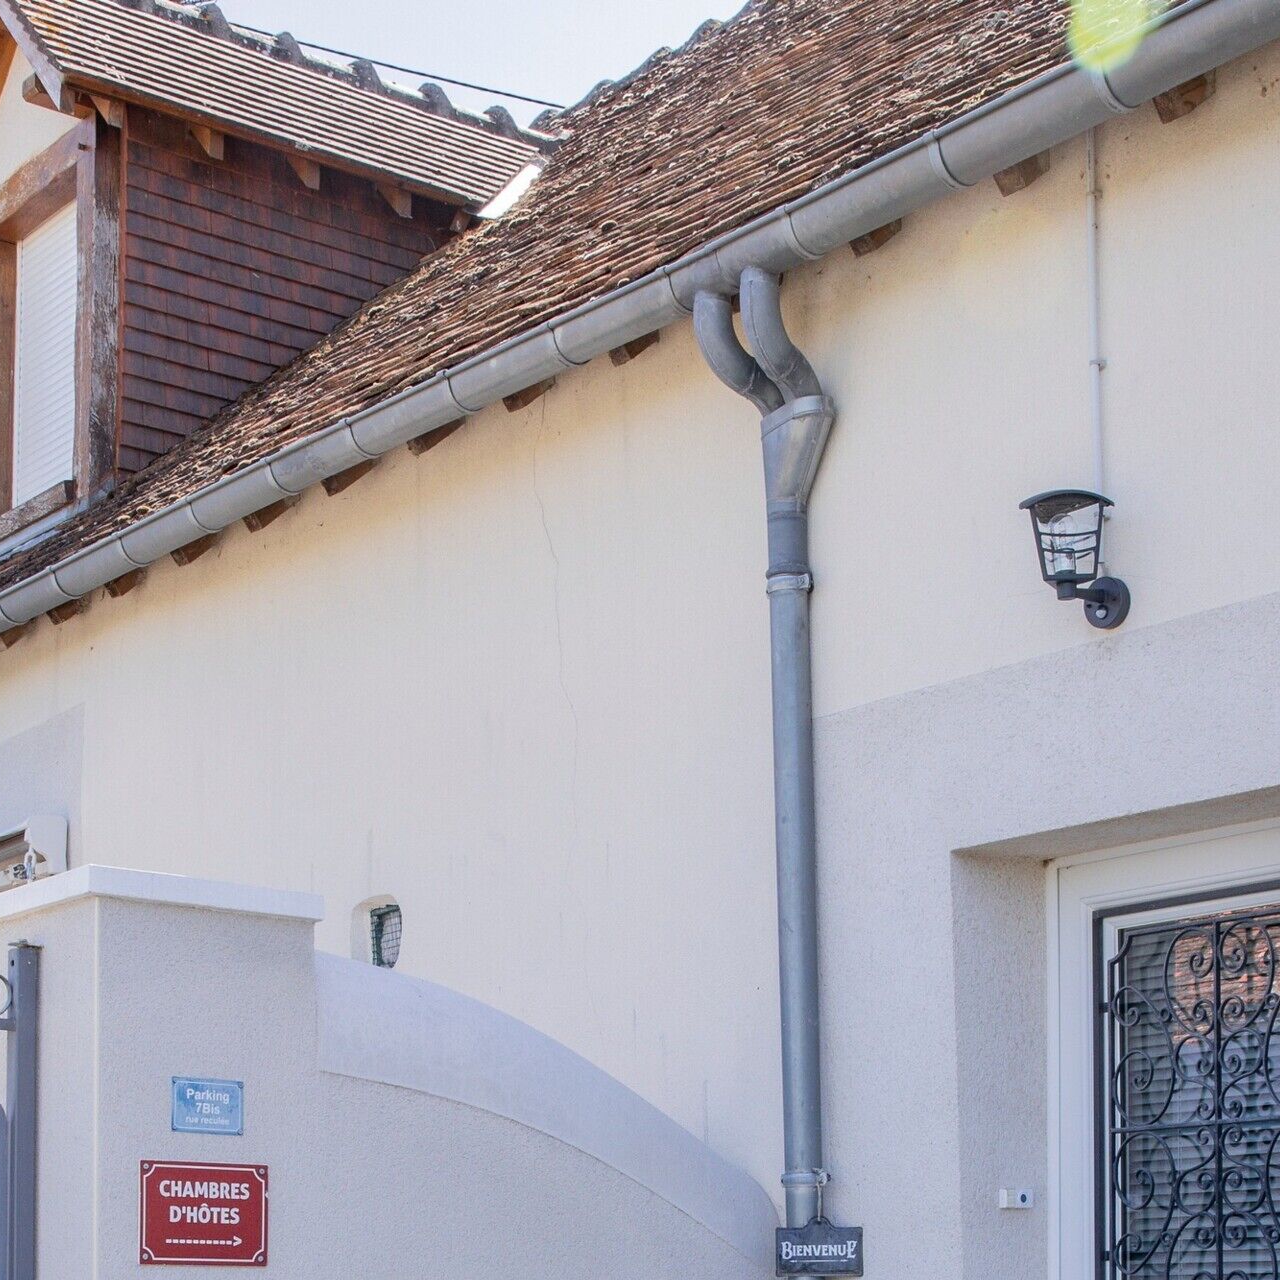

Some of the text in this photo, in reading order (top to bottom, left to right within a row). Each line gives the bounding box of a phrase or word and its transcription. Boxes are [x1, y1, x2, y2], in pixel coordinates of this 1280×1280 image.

[186, 1088, 230, 1104] Parking
[195, 1102, 220, 1115] 7Bis
[159, 1180, 250, 1200] CHAMBRES
[169, 1203, 240, 1224] D'HÔTES
[781, 1240, 858, 1260] BIENVENUE
